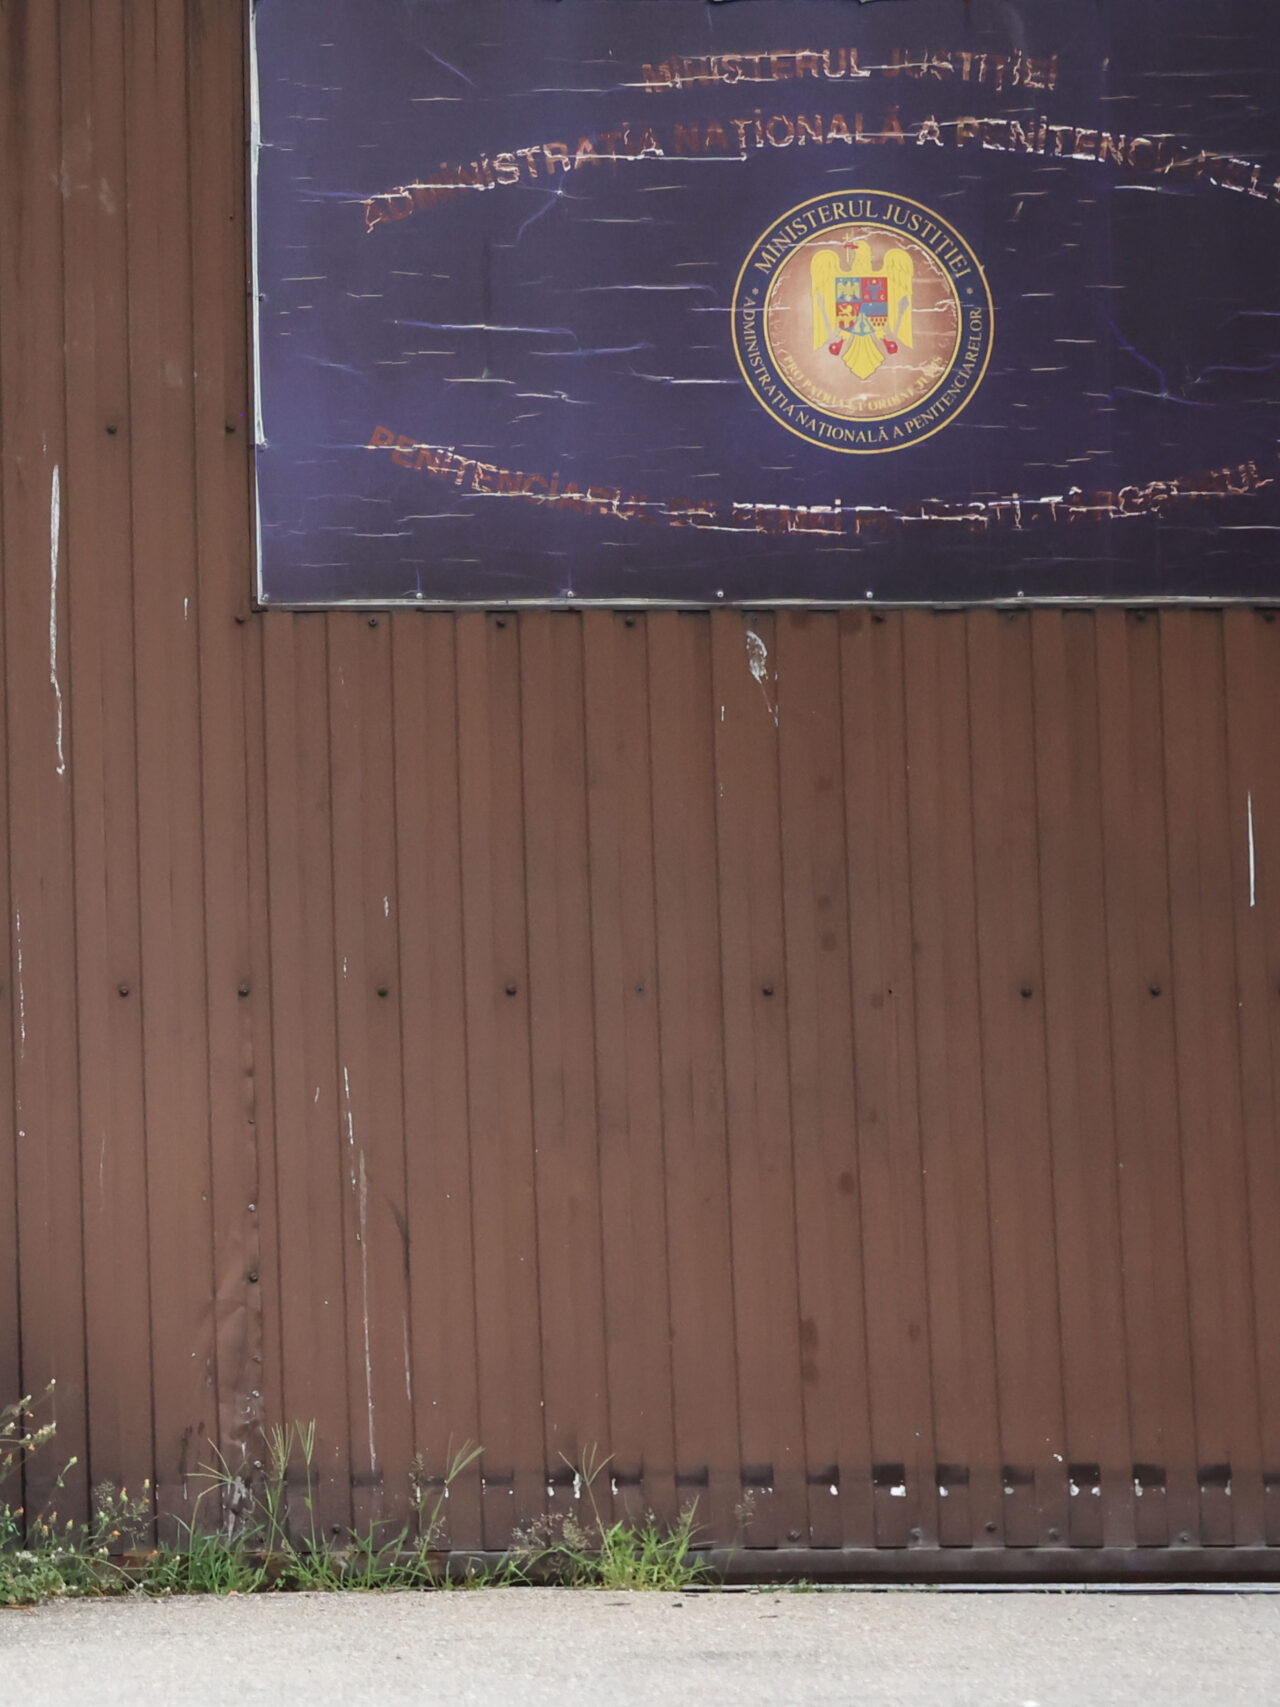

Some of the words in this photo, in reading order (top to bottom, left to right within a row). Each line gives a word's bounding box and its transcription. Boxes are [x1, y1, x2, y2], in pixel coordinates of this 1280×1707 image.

[754, 200, 878, 274] MINISTERUL
[882, 204, 972, 279] JUSTIȚIEI
[742, 296, 796, 417] ADMINISTRAȚIA
[893, 425, 904, 439] A
[904, 306, 983, 434] PENITENCIARELOR
